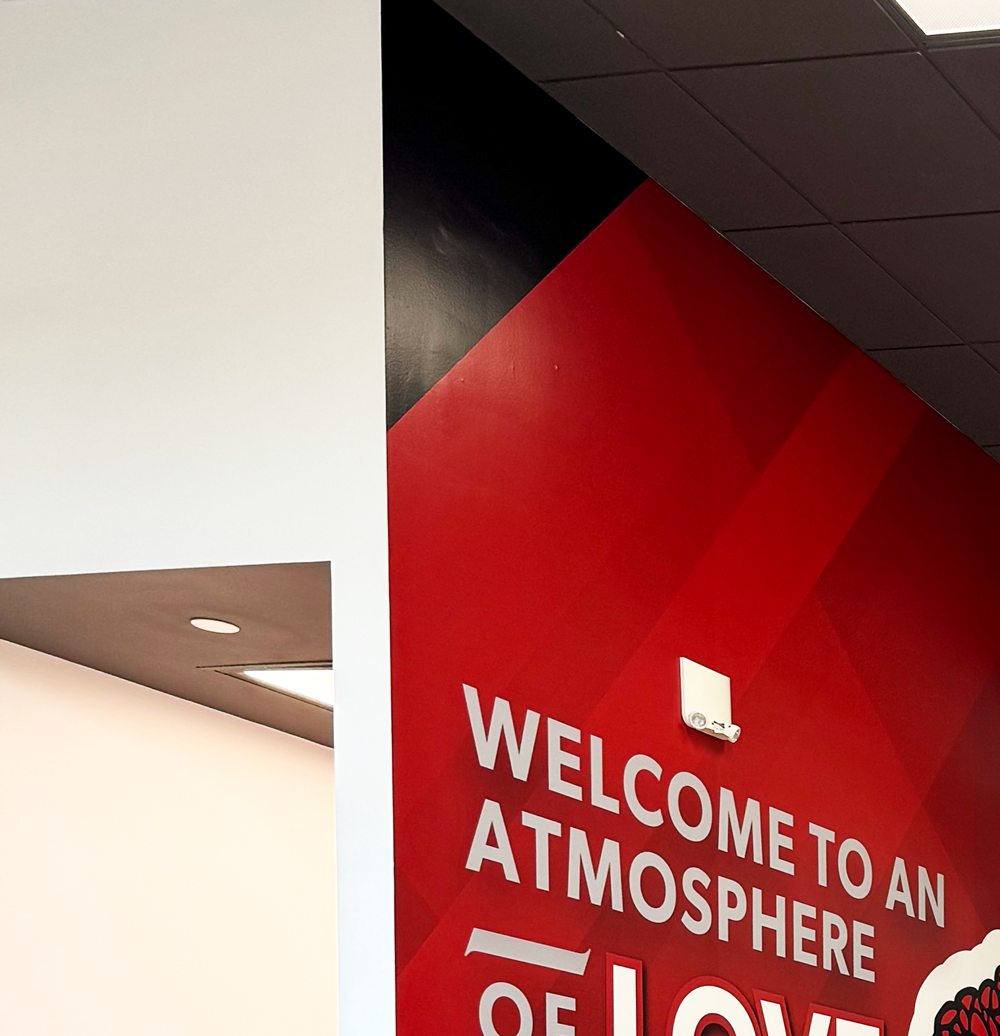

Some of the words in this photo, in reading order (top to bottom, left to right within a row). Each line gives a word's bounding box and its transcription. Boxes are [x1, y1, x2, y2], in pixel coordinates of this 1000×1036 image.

[462, 683, 795, 876] WELCOME
[808, 822, 873, 899] TO
[884, 857, 945, 928] AN
[464, 798, 876, 983] ATMOSPHERE
